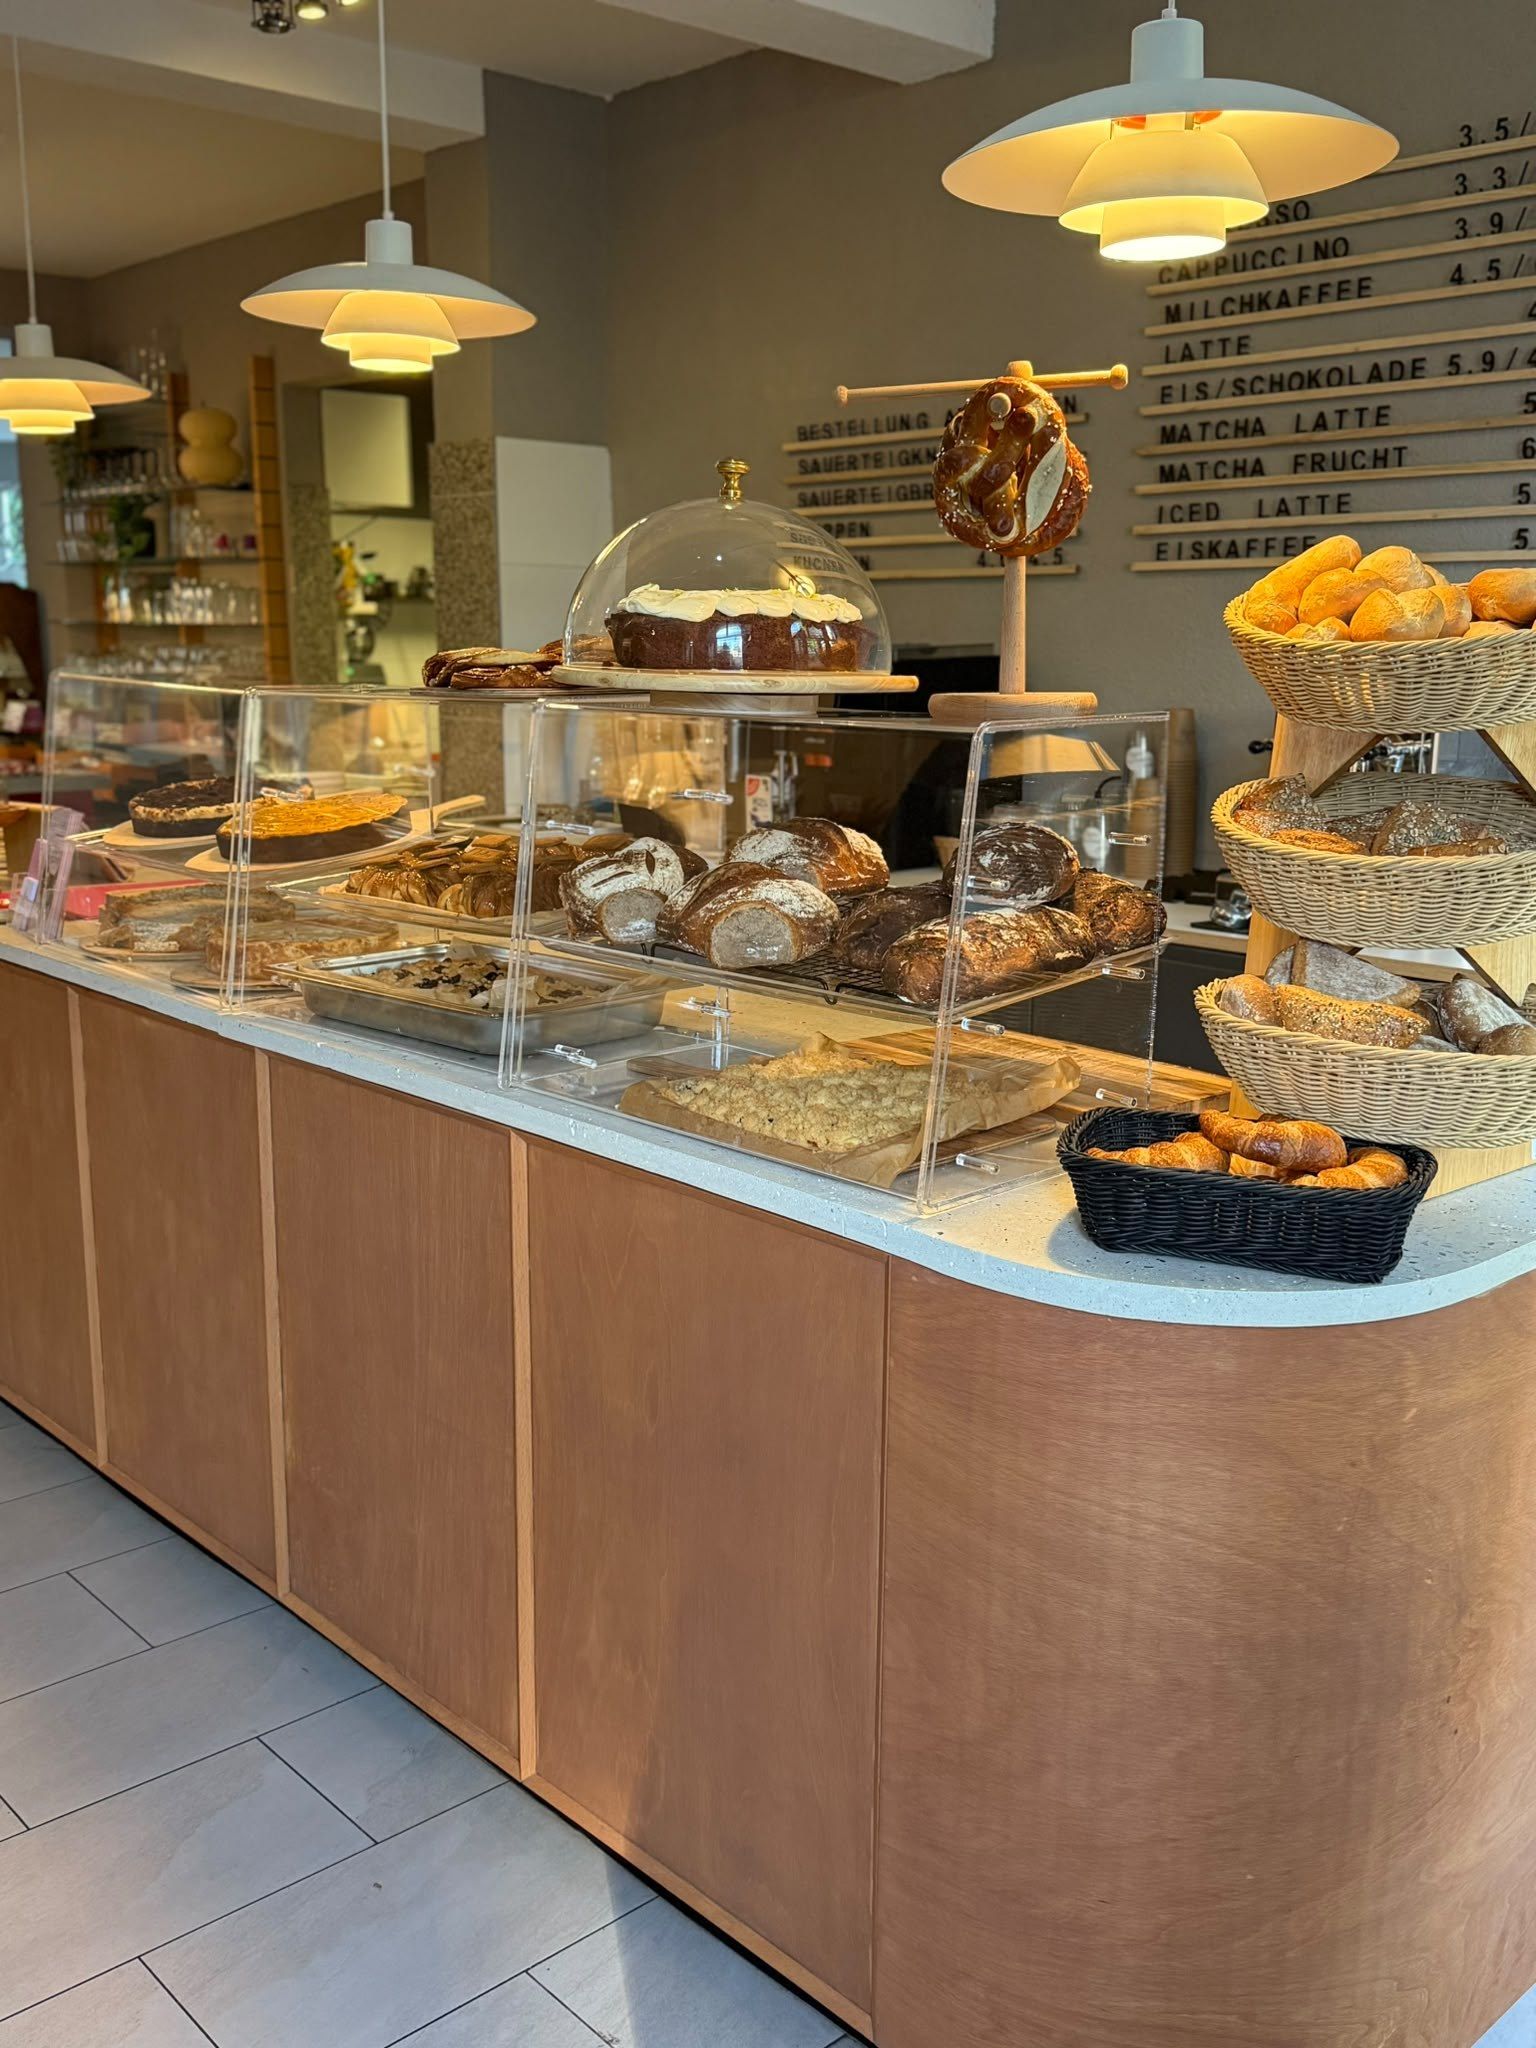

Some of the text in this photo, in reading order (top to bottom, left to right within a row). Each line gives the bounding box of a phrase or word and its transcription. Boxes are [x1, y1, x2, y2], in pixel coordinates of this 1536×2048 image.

[1158, 236, 1350, 285] CAPPUCCINO
[1164, 253, 1536, 325] MILCHKAFFEE 4.5/
[1164, 335, 1251, 365] LATTE
[1159, 357, 1428, 405] EIS/SCHOKOLADE
[796, 412, 929, 442] BESTELLUNG
[1159, 416, 1267, 445] MATCHA
[1294, 405, 1392, 434] LATTE
[797, 447, 936, 476] SAUERTEIGKN
[1158, 456, 1266, 484] MATCHA
[1292, 446, 1409, 475] FRUCHT
[797, 482, 934, 508] SAUERTEIGBR
[1157, 501, 1221, 524] ICED
[1257, 493, 1352, 519] LATTE
[1155, 535, 1317, 562] EISKAFFEE
